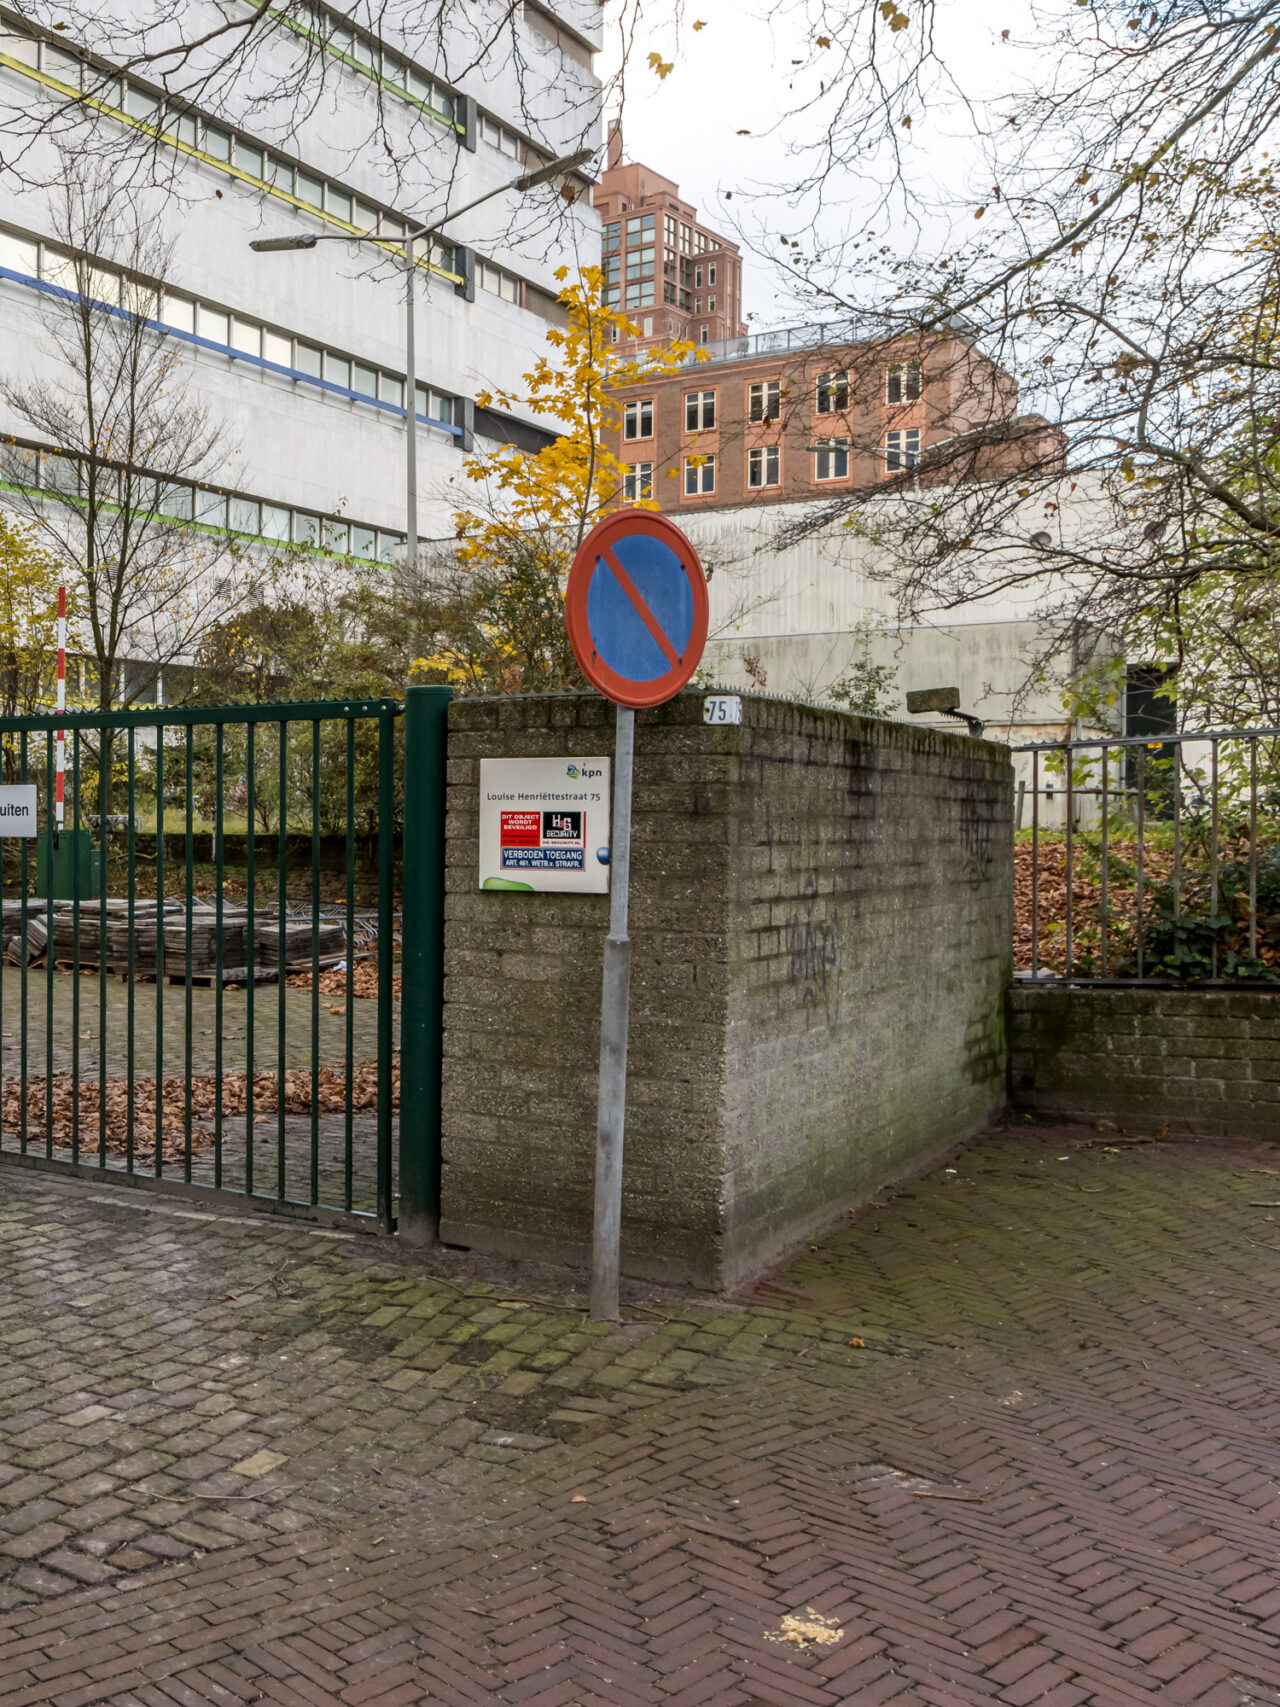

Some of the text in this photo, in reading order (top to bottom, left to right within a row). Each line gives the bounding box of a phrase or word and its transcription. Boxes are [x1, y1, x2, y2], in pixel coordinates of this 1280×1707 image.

[709, 701, 727, 721] 75
[581, 768, 602, 778] kpn
[487, 792, 601, 802] Louise Henriëttestraat 75
[546, 830, 578, 838] SECURITY
[504, 850, 582, 860] VERBODEN TOEGANG
